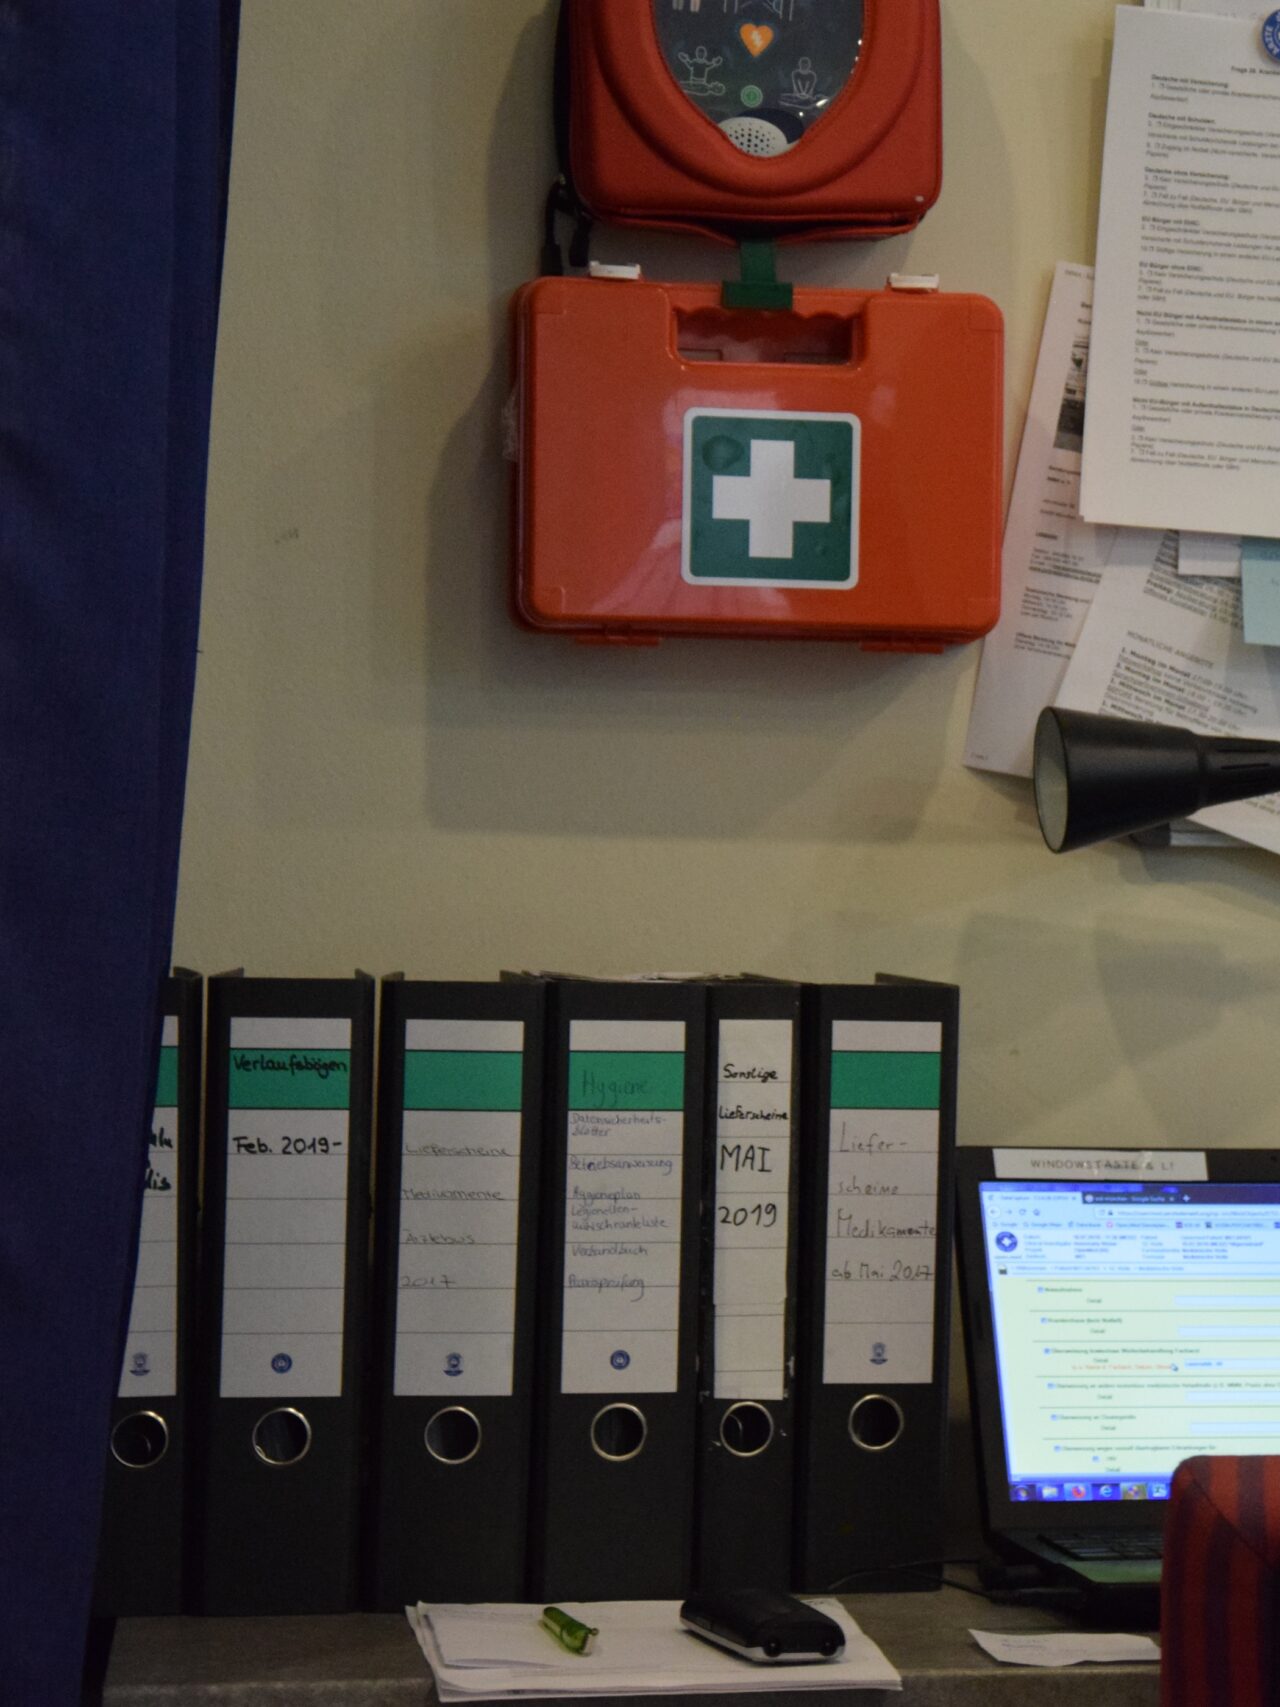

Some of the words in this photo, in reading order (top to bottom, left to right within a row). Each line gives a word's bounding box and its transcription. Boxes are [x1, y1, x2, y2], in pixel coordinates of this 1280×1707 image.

[234, 1055, 347, 1078] Verlaufsbögen
[723, 1064, 778, 1083] Sonstige
[583, 1070, 649, 1107] Hygiene
[233, 1137, 272, 1154] Feb.
[720, 1144, 772, 1173] MAI
[719, 1203, 777, 1227] 2019
